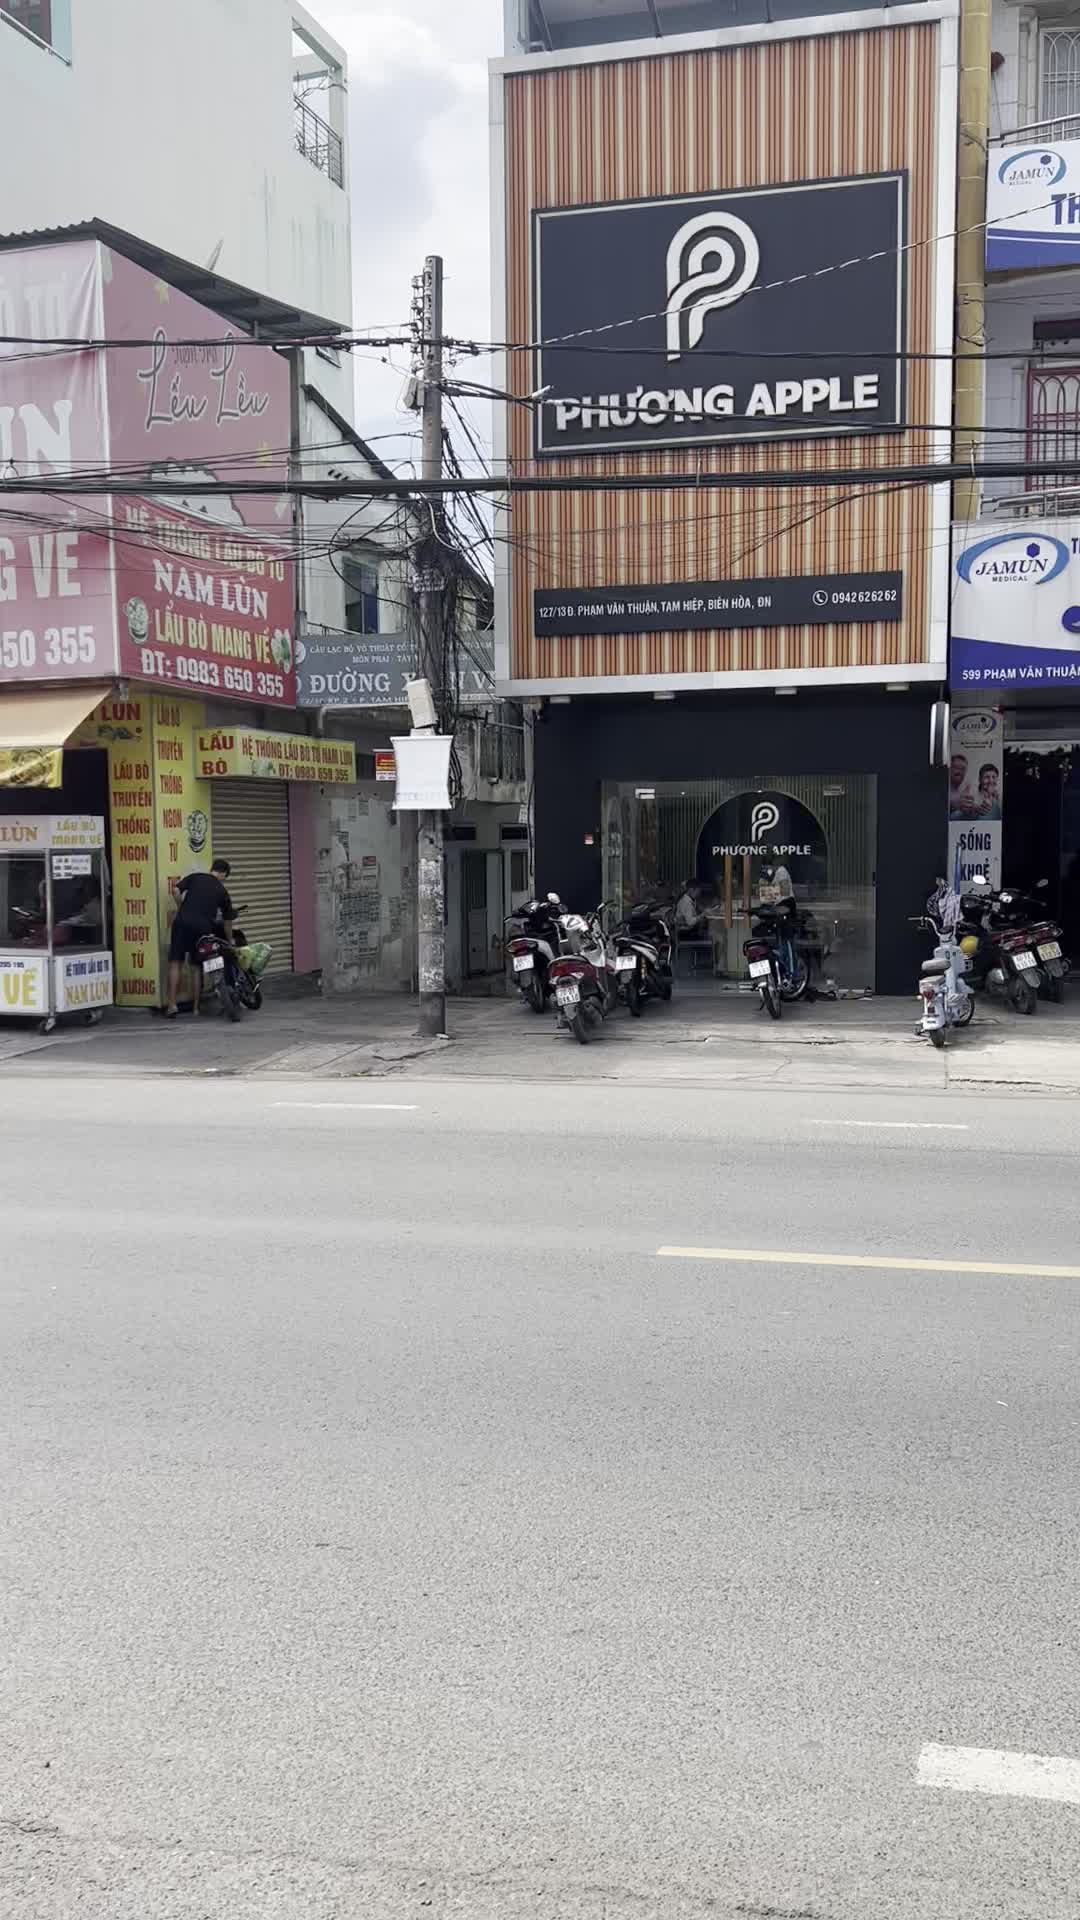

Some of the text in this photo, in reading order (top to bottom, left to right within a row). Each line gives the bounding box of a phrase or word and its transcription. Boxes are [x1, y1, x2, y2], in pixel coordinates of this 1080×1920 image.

[1008, 167, 1056, 181] JAMUN
[556, 373, 879, 431] PHƯƠNG APPLE
[975, 558, 1049, 576] JAMUN
[992, 575, 1029, 583] MEDICAL
[152, 558, 268, 621] NAM LÙN
[831, 590, 898, 604] 0942626262
[660, 599, 681, 612] TAM
[731, 594, 756, 610] HÒA,
[757, 595, 772, 609] ĐN
[154, 600, 186, 646] LẨU
[187, 613, 209, 651] BÒ
[210, 623, 252, 660] MANG
[0, 624, 96, 669] 50 355
[140, 647, 173, 679] ĐT:
[175, 655, 220, 688] 0983
[223, 665, 253, 694] 650
[256, 670, 285, 698] 355
[309, 667, 392, 694] ĐƯỜNG
[962, 669, 982, 681] 599
[983, 668, 1017, 682] PHẠM
[1019, 664, 1044, 679] VĂN
[199, 730, 235, 751] LẨU
[135, 760, 150, 780] BÒ
[201, 757, 228, 775] BÒ
[117, 812, 150, 834] THỐNG
[162, 807, 183, 829] NGON
[960, 826, 992, 851] SỐNG
[119, 845, 149, 862] NGON
[711, 844, 812, 856] PHƯƠNG APPLE
[123, 926, 151, 945] NGỌT
